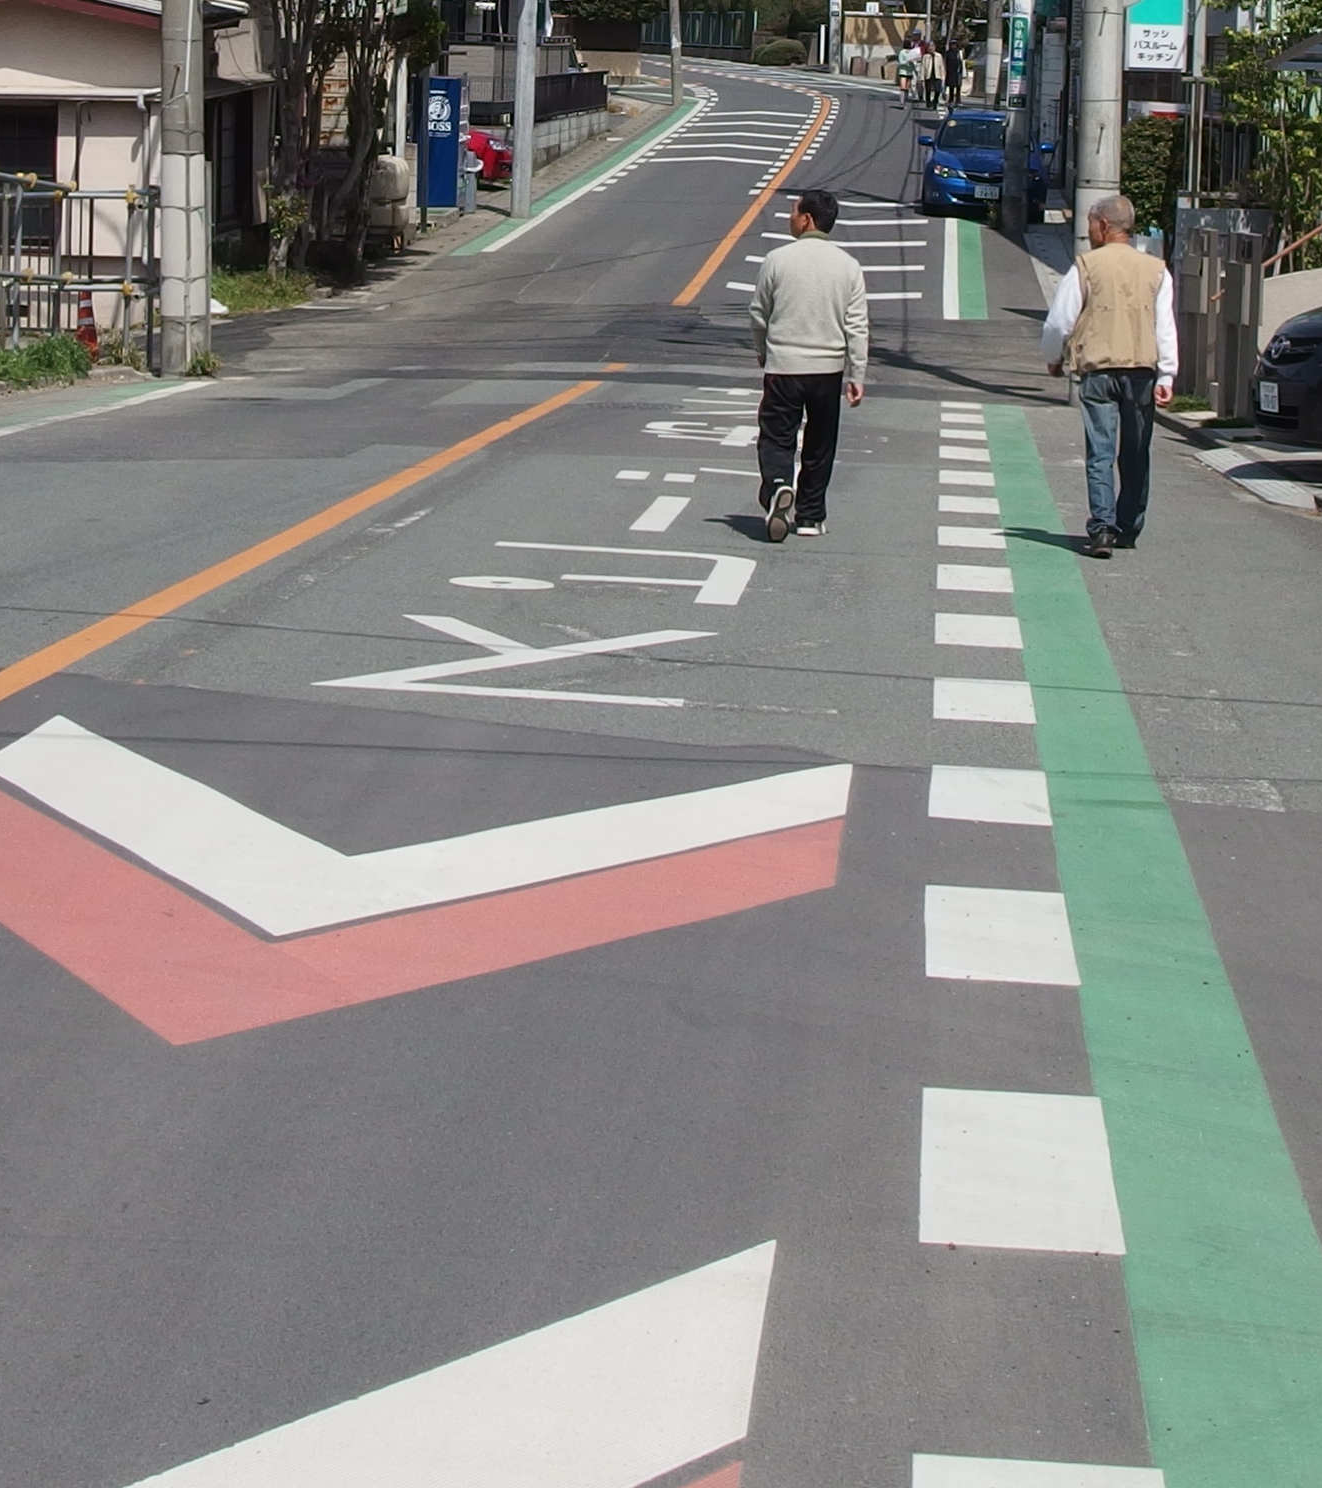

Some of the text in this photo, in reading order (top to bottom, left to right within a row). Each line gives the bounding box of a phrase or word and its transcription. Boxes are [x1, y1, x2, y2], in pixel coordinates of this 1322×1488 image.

[1142, 29, 1170, 38] サッシ
[1133, 40, 1178, 50] バスルーム
[1136, 52, 1174, 62] キッチン
